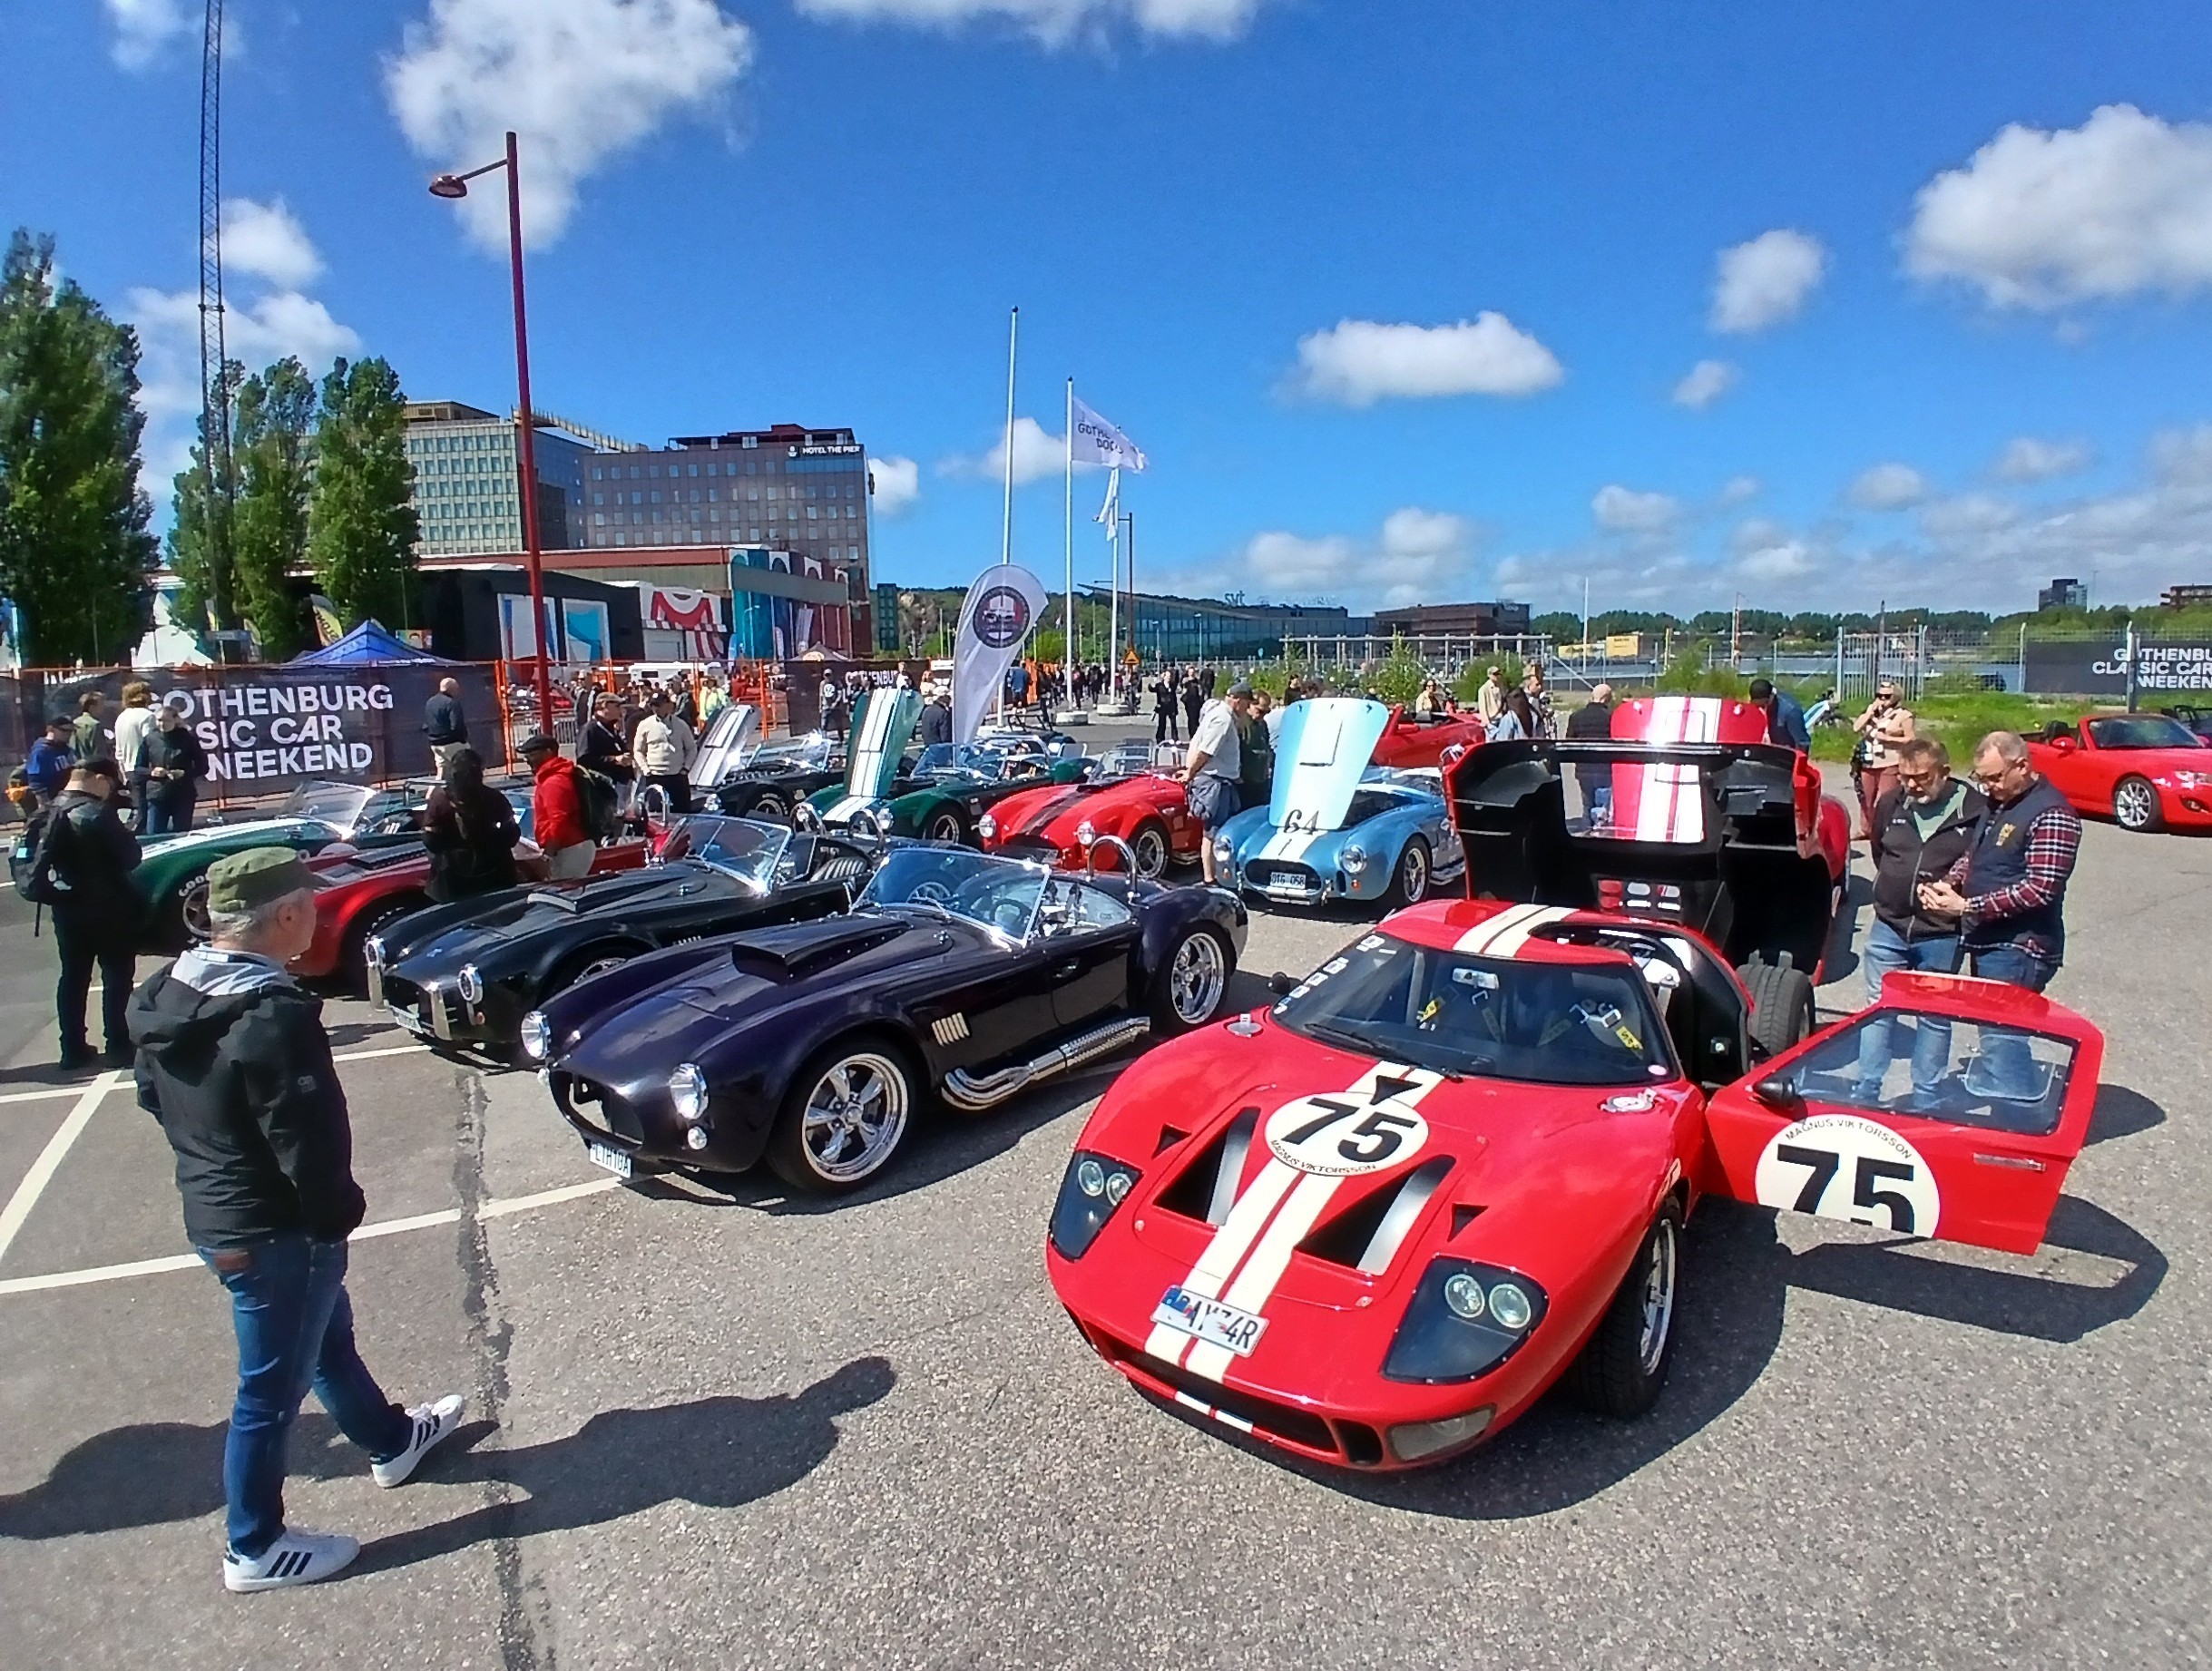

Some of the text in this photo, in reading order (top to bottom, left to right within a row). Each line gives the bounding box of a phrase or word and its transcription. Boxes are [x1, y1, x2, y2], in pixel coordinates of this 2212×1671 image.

[802, 445, 860, 454] HOTEL THE PIER
[2092, 661, 2212, 675] CLASIC CAR
[2114, 648, 2212, 661] GTHENBU
[149, 684, 393, 719] OTHENBURG
[270, 714, 344, 745] CAR
[1283, 808, 1320, 836] 64
[1281, 1097, 1418, 1163] 75
[1786, 1118, 1913, 1159] MAGNUS VIKTORSSON
[1776, 1143, 1915, 1234] 75
